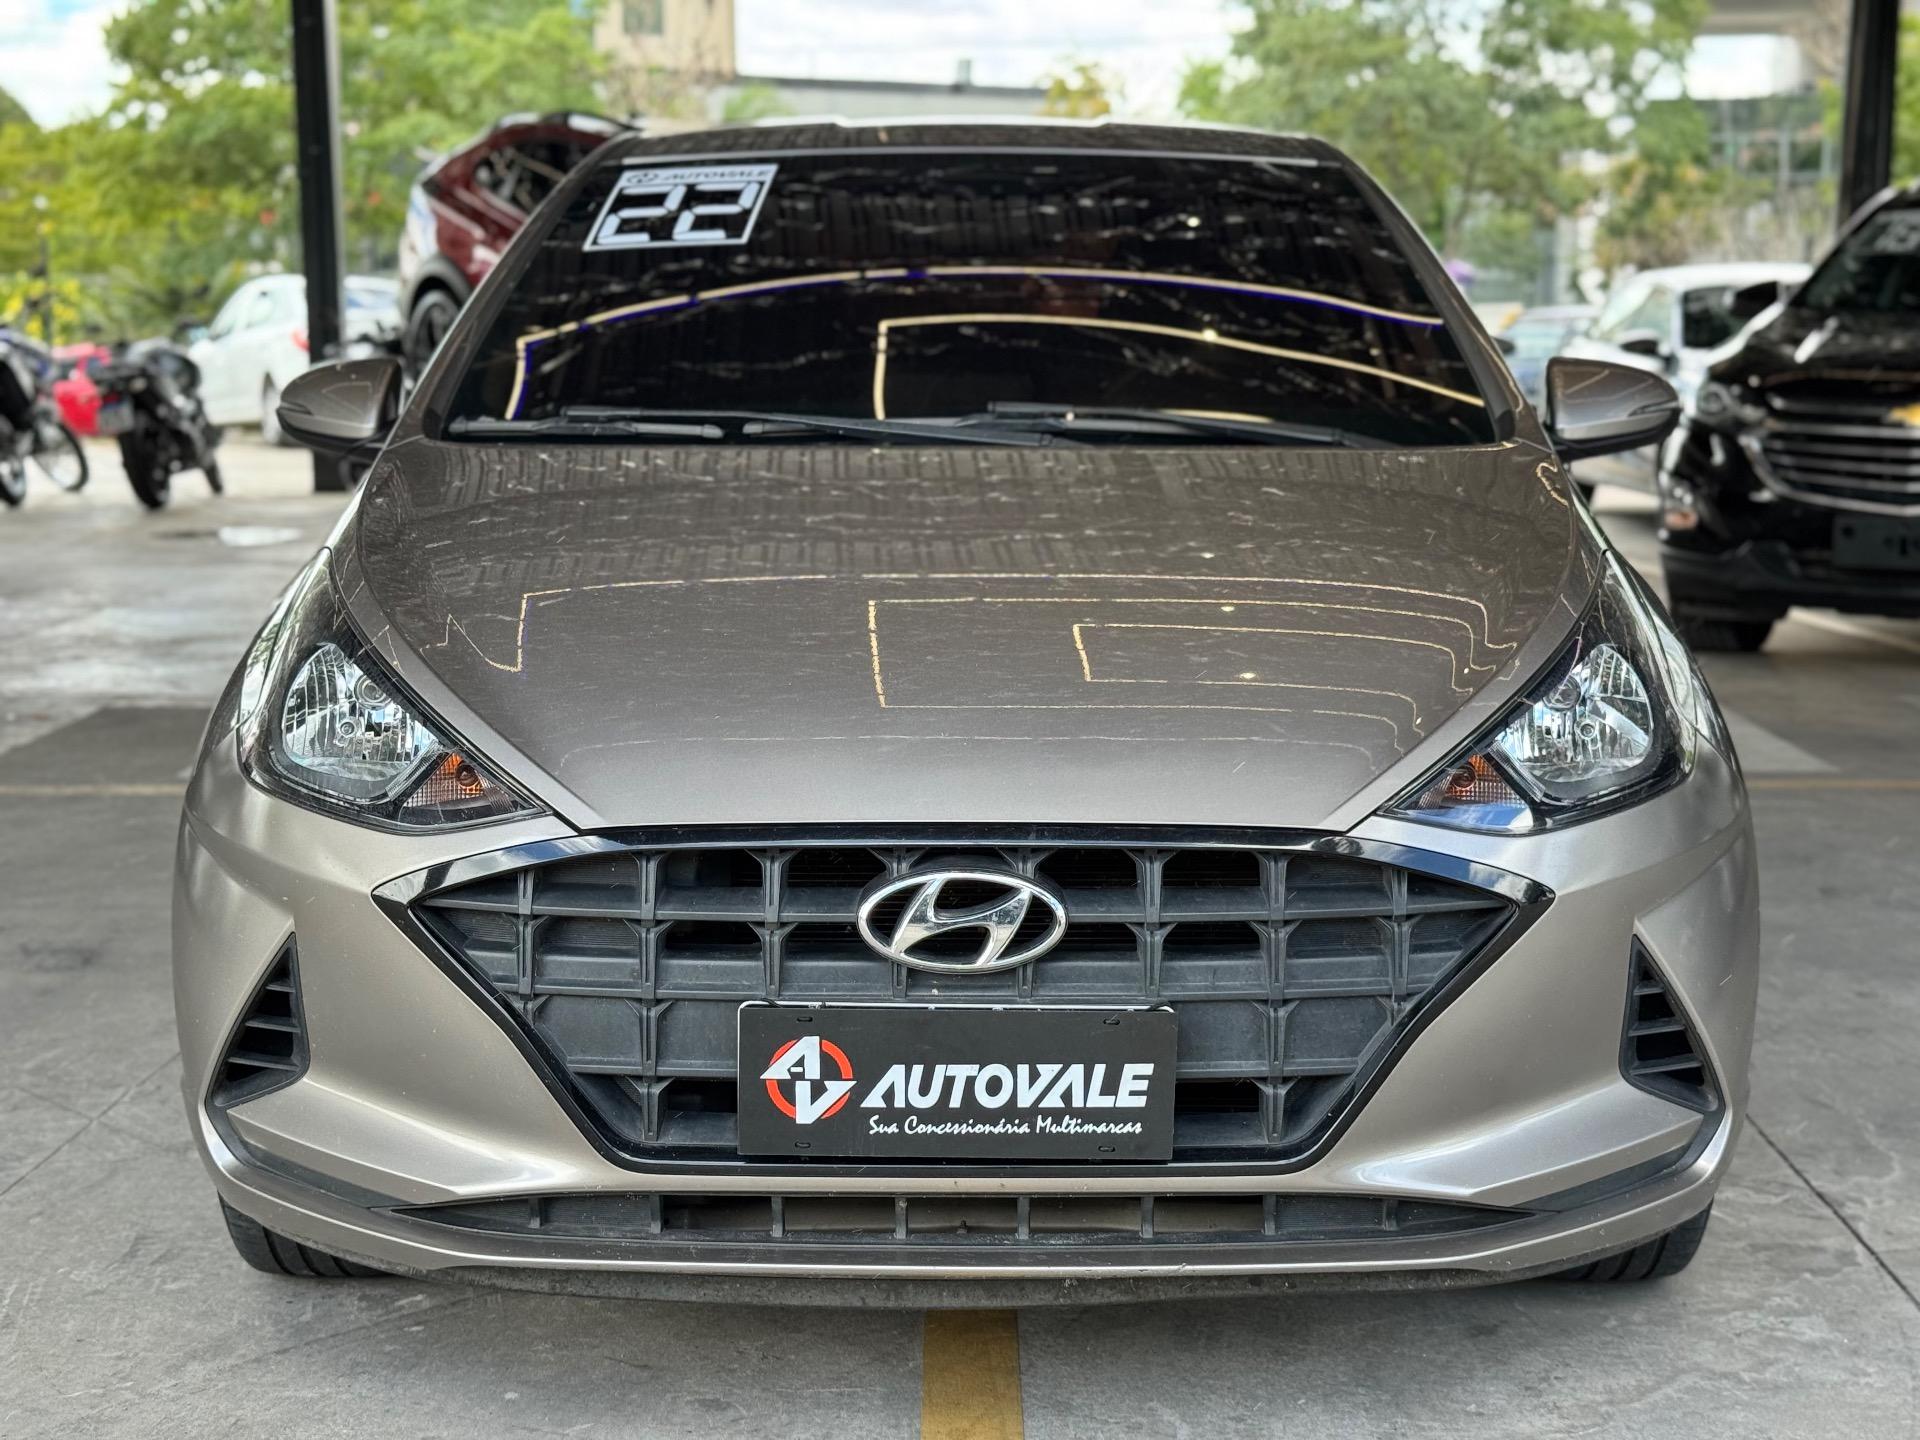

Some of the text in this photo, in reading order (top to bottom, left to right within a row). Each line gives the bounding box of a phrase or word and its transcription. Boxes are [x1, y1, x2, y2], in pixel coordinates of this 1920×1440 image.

[596, 181, 760, 245] 22
[860, 1063, 1155, 1109] AUTOVALE
[868, 1114, 1143, 1135] Sua Concessionária Multimarcas
